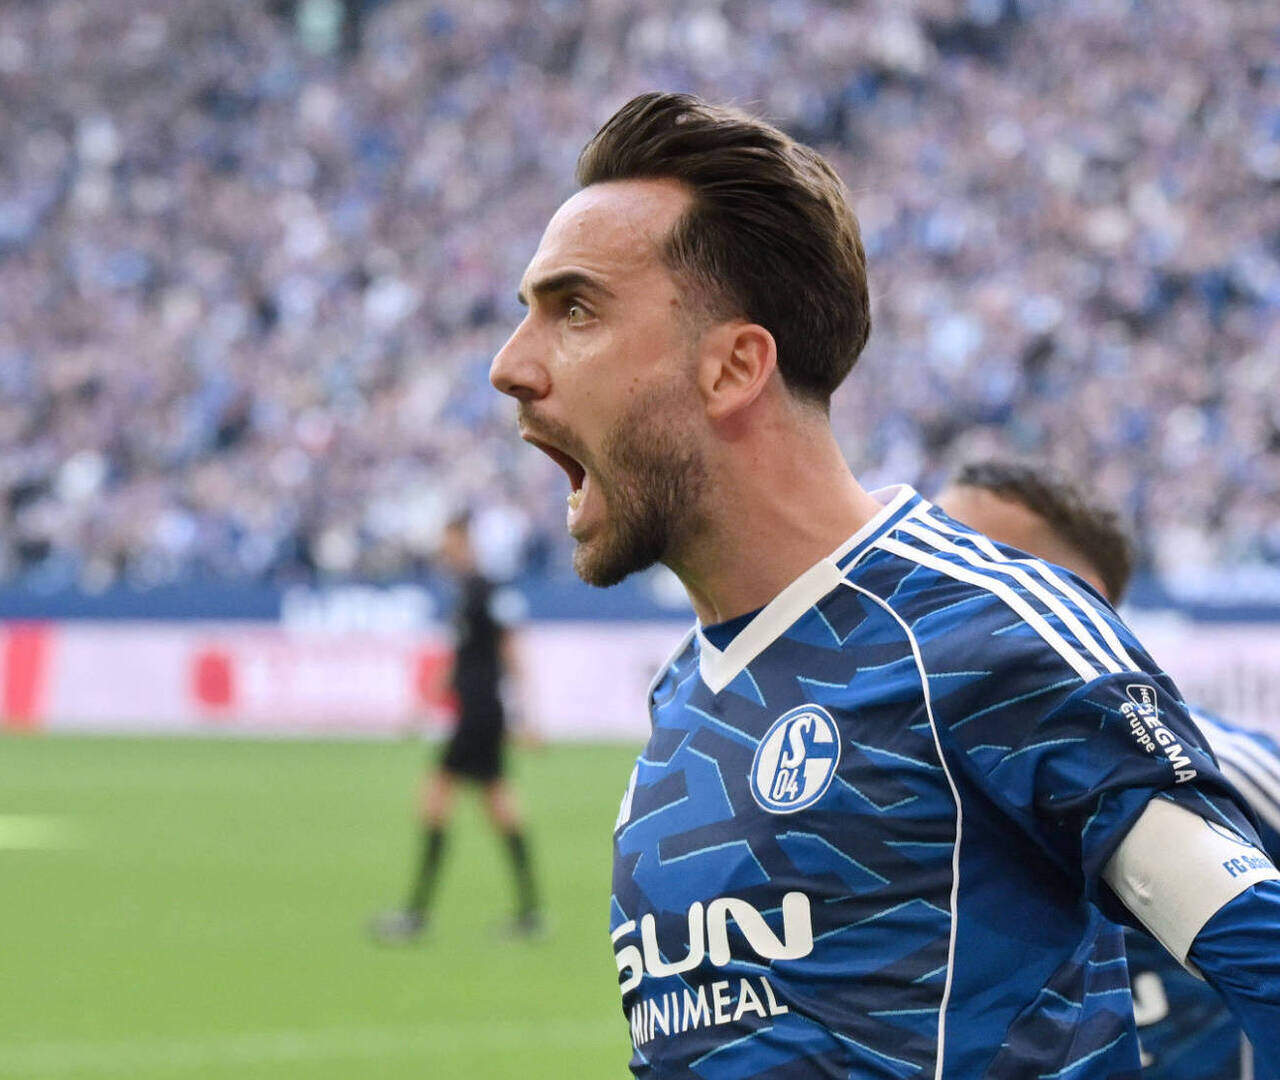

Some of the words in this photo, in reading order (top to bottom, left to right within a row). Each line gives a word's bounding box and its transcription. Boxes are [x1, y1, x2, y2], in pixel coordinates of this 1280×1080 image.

[1120, 701, 1156, 754] Gruppe
[772, 767, 800, 801] 04
[1222, 857, 1248, 878] FC
[610, 891, 814, 996] SUN
[631, 976, 789, 1049] MINIMEAL
